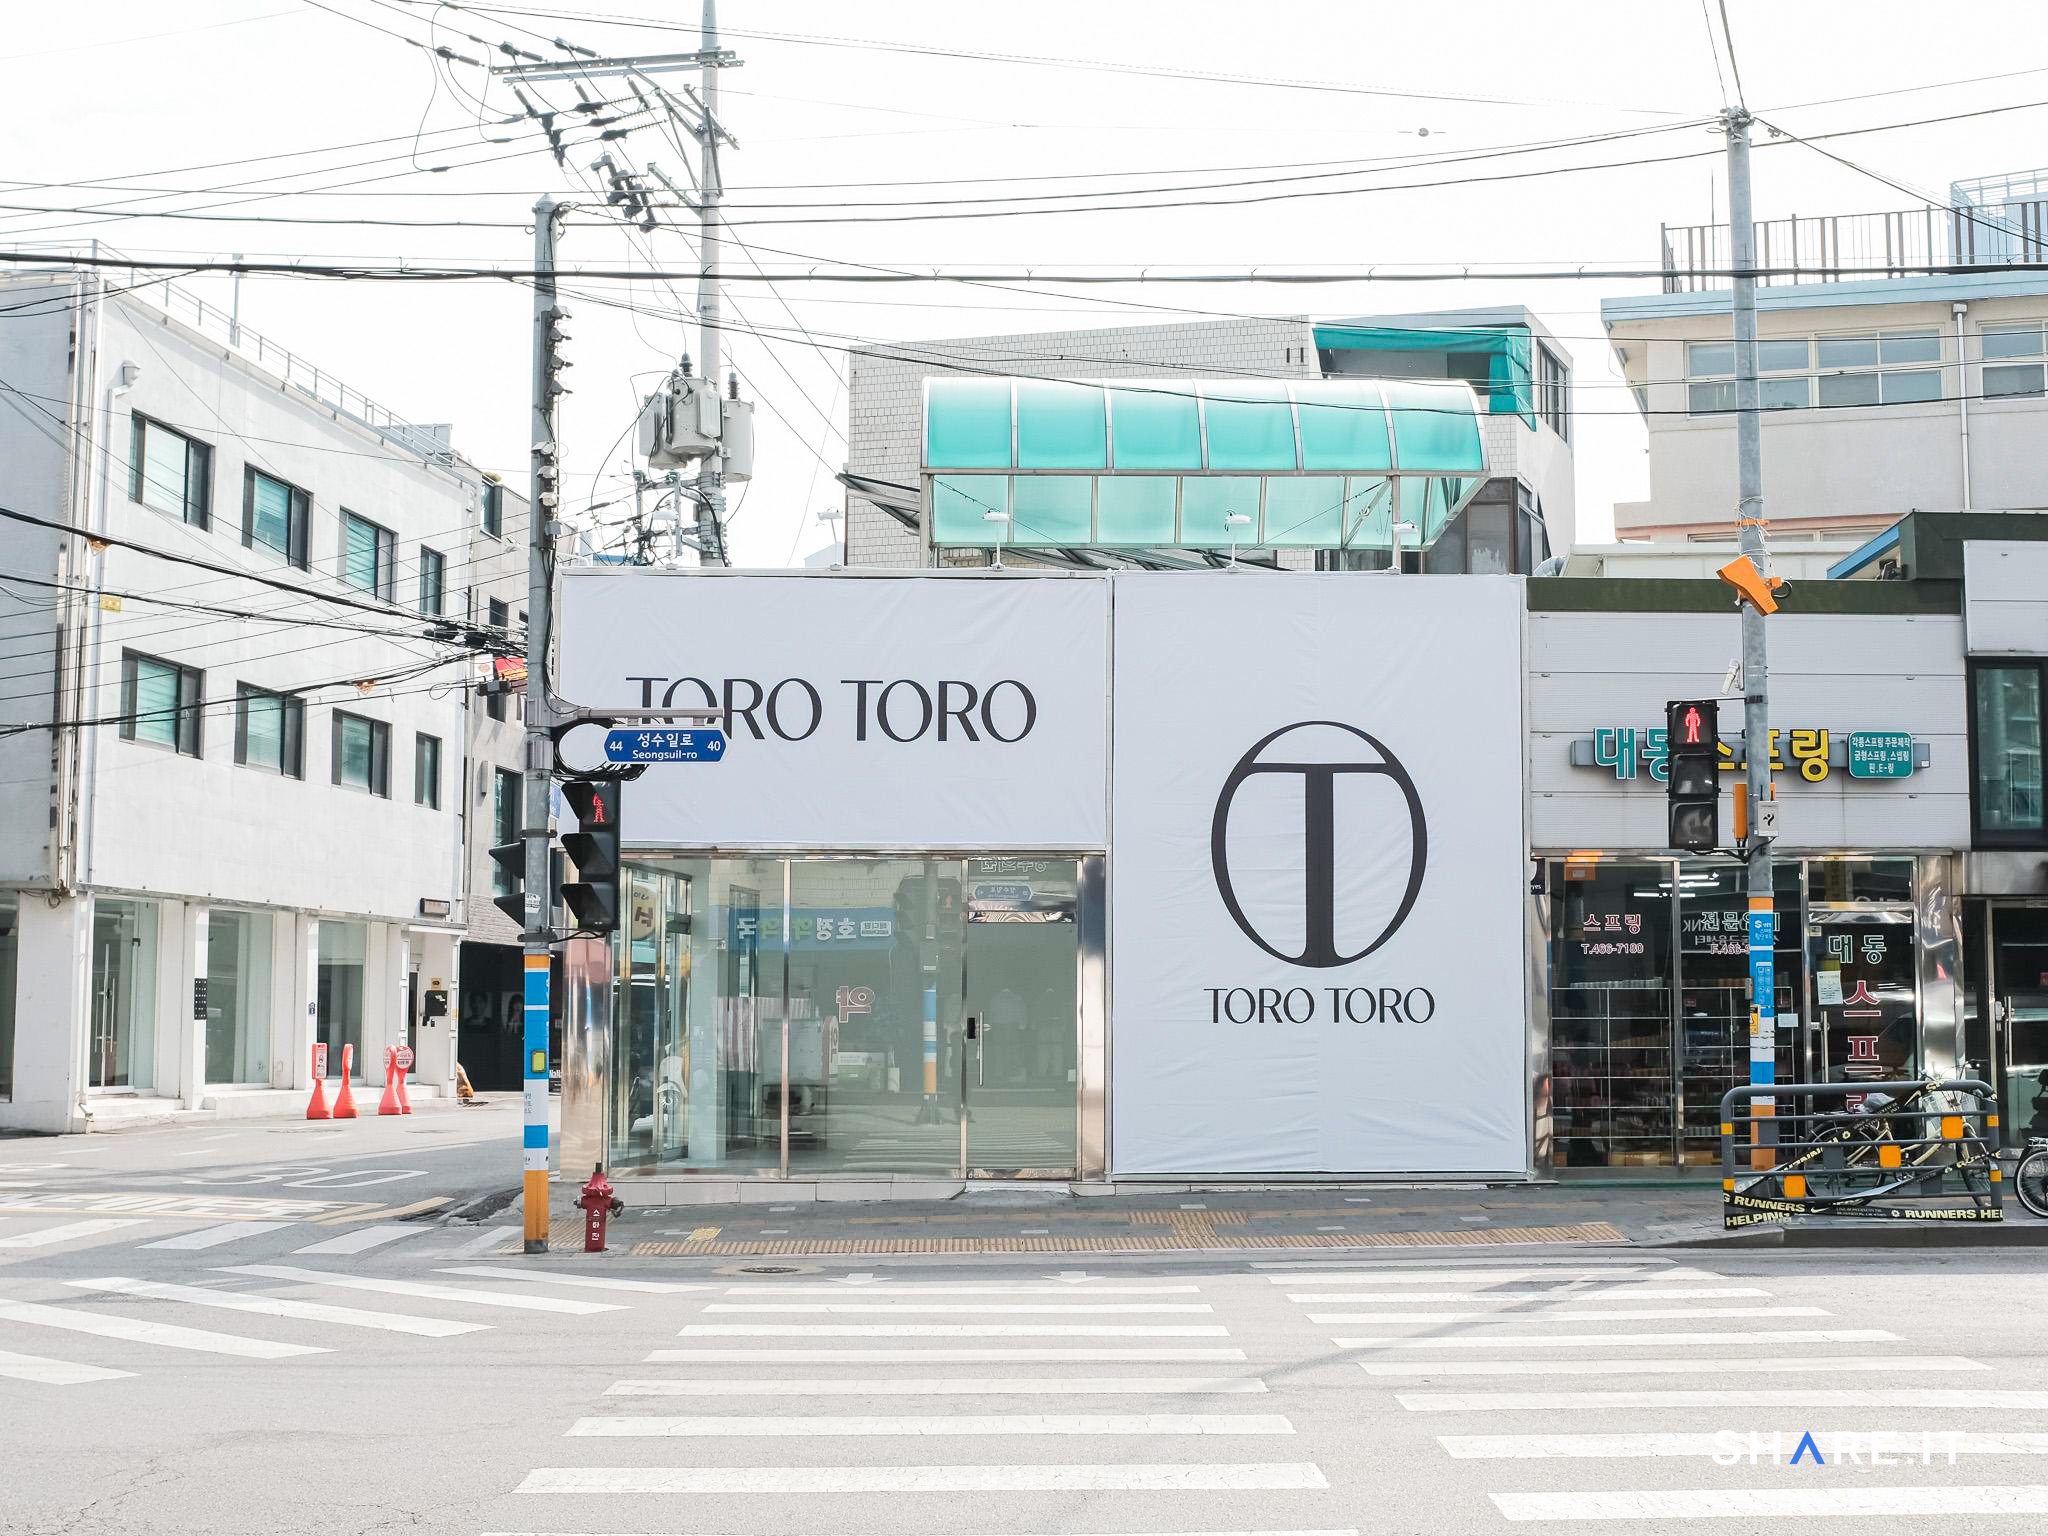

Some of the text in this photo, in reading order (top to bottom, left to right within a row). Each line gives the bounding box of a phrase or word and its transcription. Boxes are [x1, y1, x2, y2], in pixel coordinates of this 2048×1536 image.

[626, 677, 1036, 742] TORO TORO
[609, 733, 721, 752] 44 성수일로 40
[632, 750, 698, 760] Seongsuil-ro
[1583, 914, 1641, 934] 스프링
[1829, 935, 1887, 964] 대동
[1204, 987, 1435, 1024] TORO TORO
[1734, 1196, 1806, 1213] RUNNERS
[1905, 1209, 1977, 1219] RUNNERS
